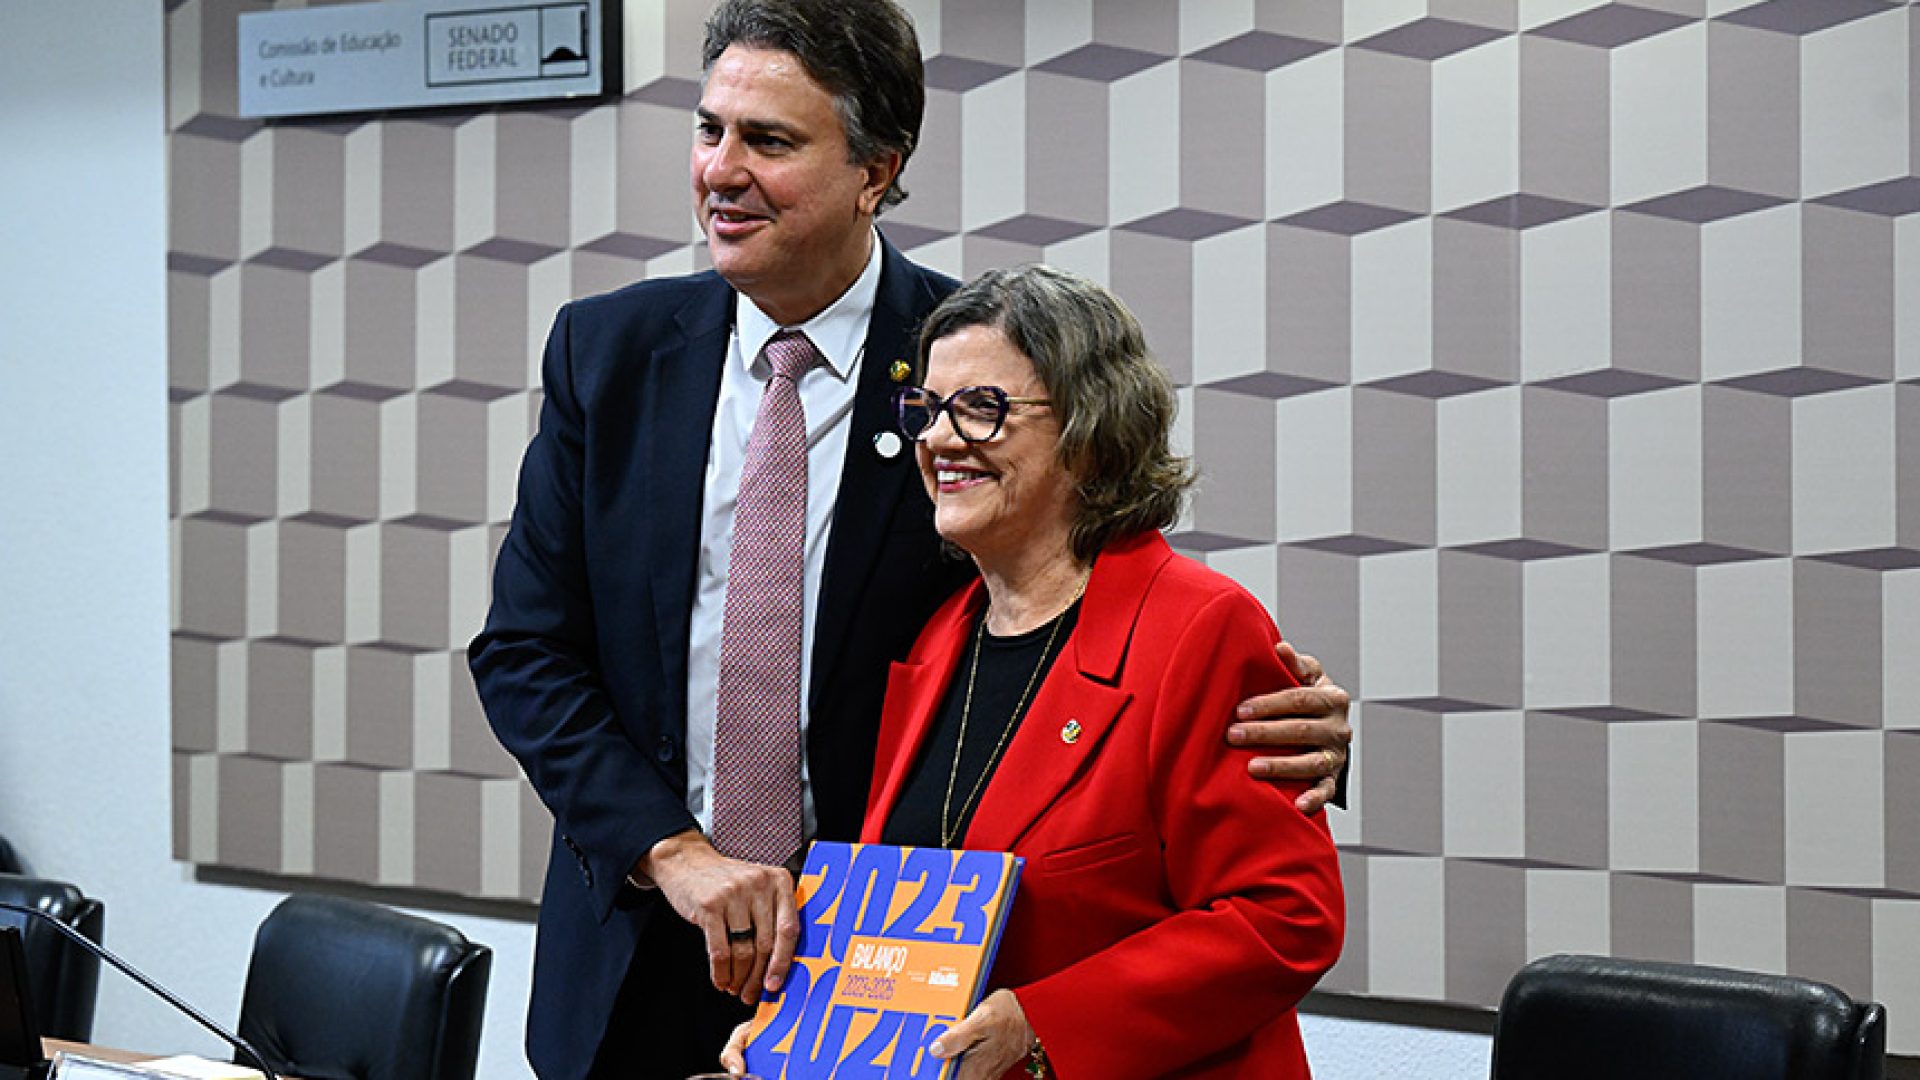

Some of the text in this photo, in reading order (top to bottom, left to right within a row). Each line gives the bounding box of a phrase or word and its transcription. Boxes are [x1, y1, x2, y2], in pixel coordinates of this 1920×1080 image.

[320, 37, 337, 55] de
[341, 31, 401, 55] Educação
[448, 22, 518, 48] SENADO
[448, 48, 518, 71] FEDERAL
[271, 68, 315, 88] Cultura
[797, 841, 1004, 964] 2023
[851, 943, 908, 977] BALANÇO
